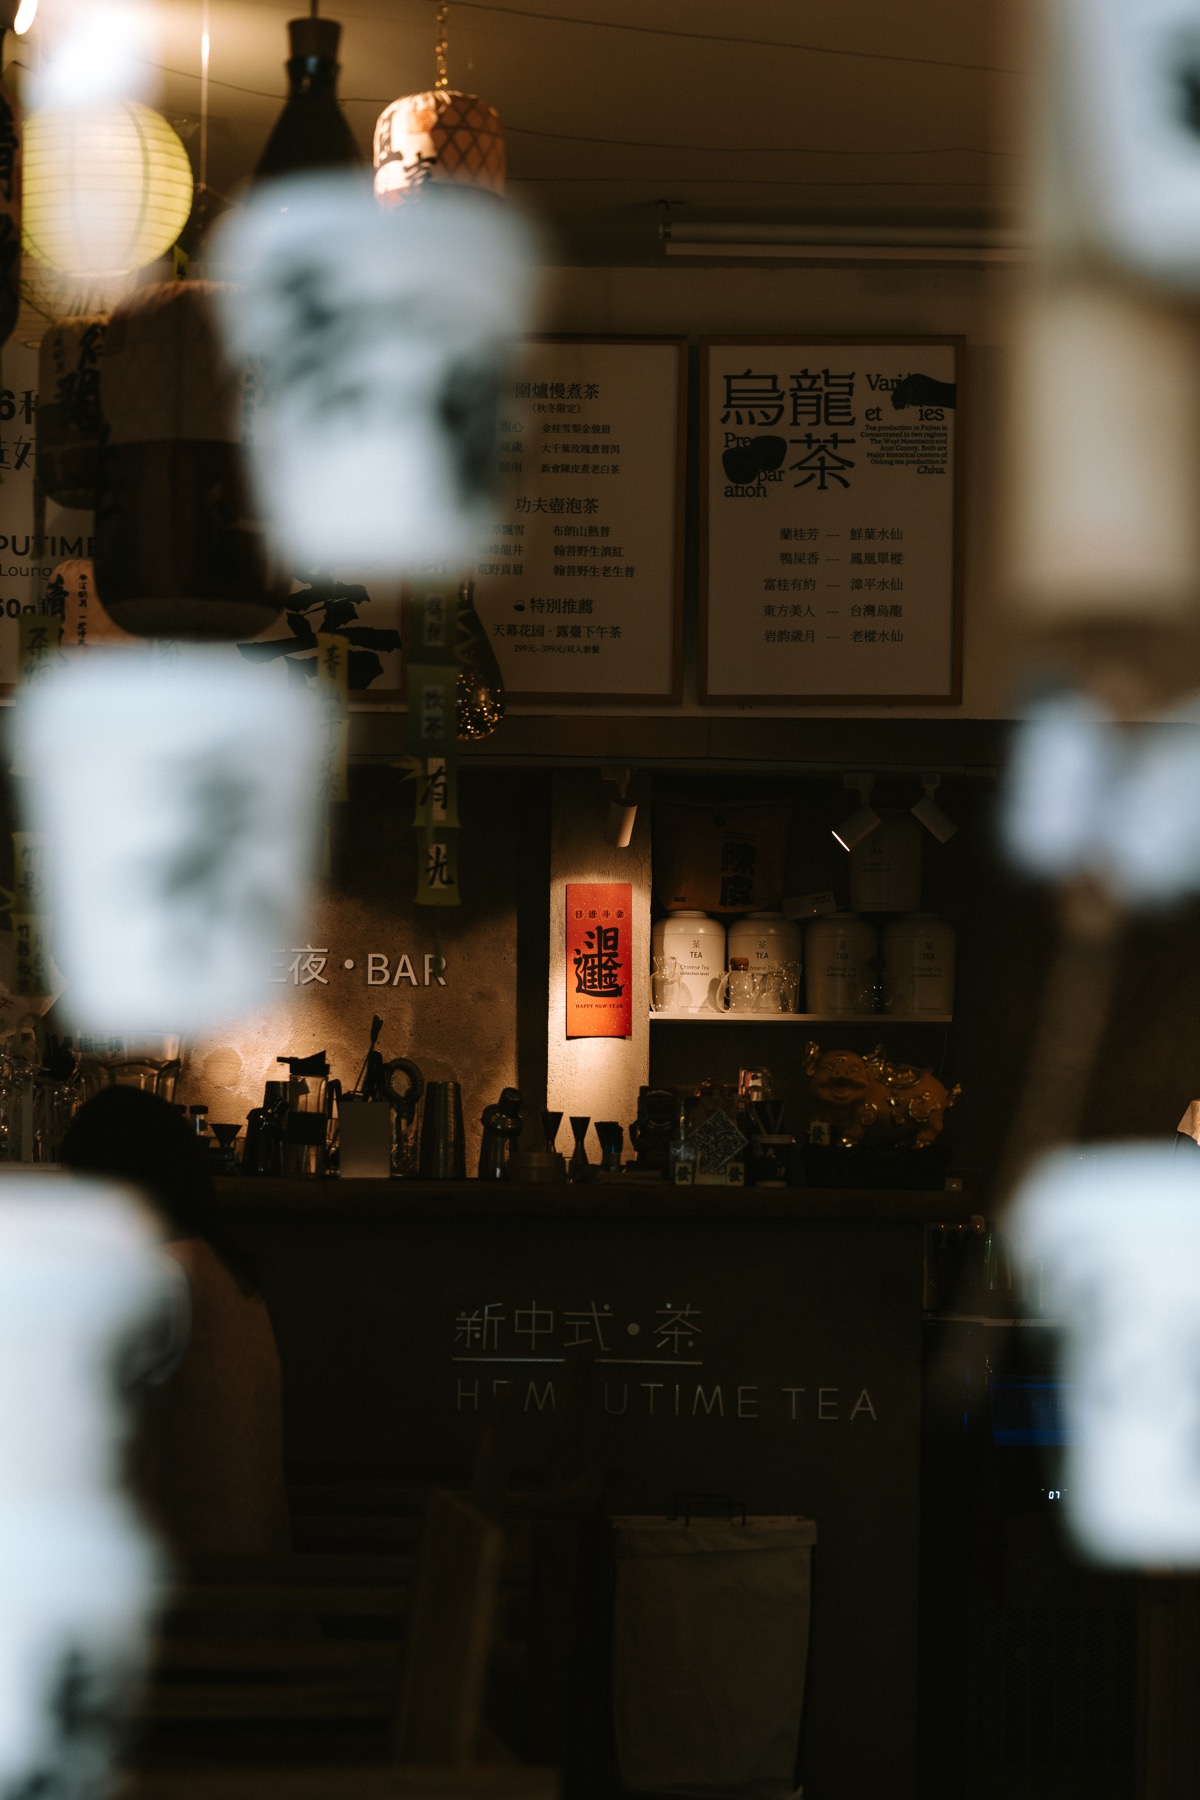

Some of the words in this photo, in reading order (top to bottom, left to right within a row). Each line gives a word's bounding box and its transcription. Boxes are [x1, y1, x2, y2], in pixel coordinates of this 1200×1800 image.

[515, 382, 600, 400] 圍爐慢煮茶
[720, 368, 856, 427] 烏龍
[865, 406, 883, 421] et
[918, 405, 945, 421] ies
[724, 432, 752, 448] Pre
[788, 432, 856, 490] 茶
[756, 469, 785, 486] par
[724, 484, 768, 498] ation
[763, 604, 816, 618] 東方美人
[690, 951, 703, 959] TEA
[836, 952, 849, 960] TEA
[922, 952, 936, 960] TEA
[781, 1386, 878, 1423] TEA
